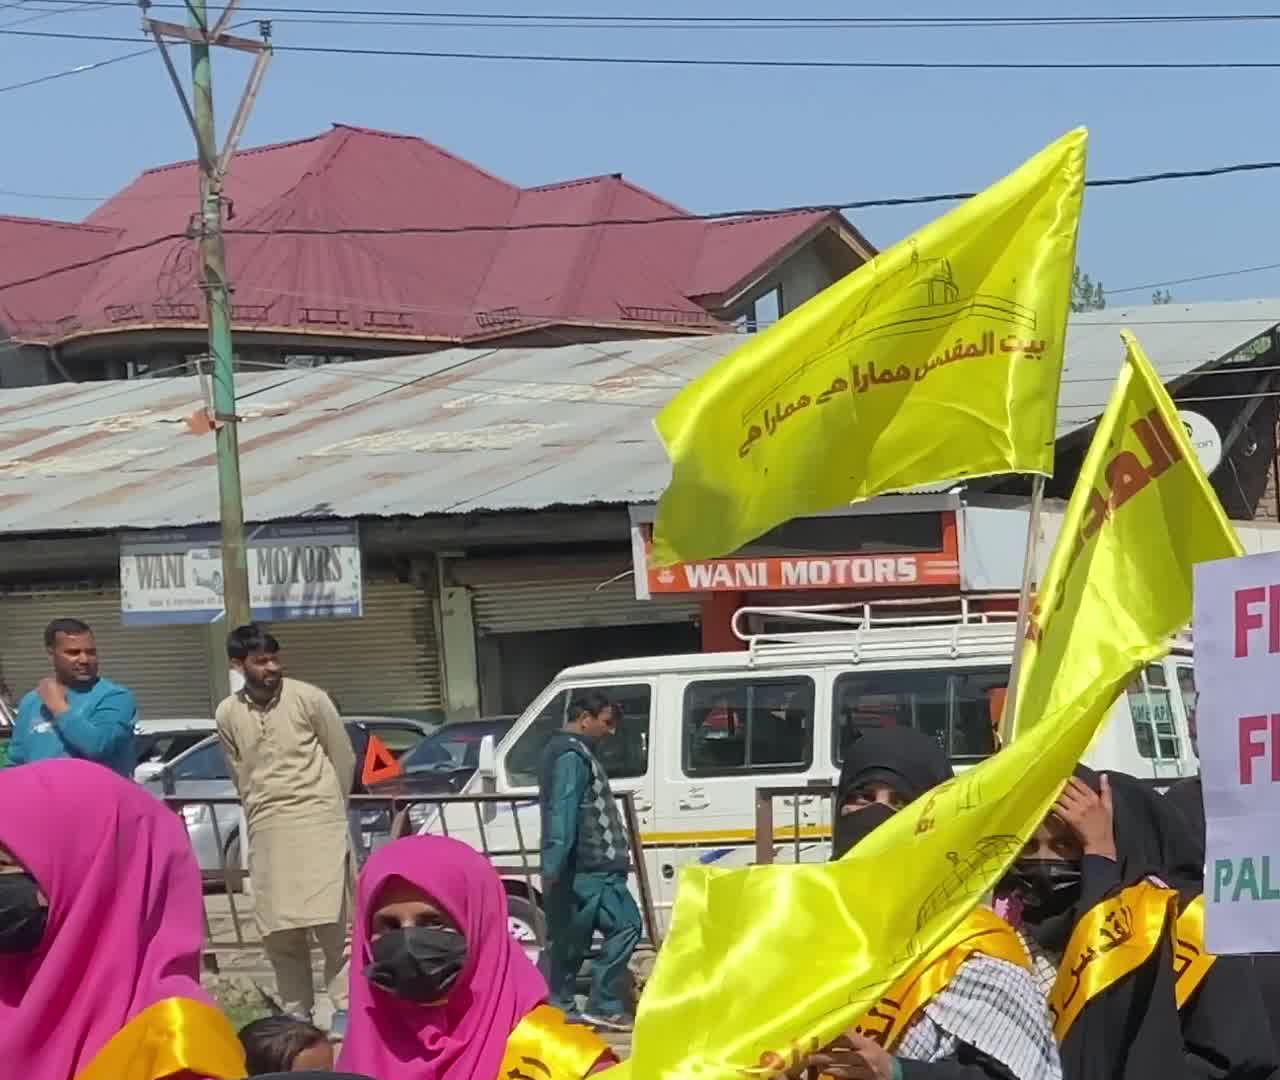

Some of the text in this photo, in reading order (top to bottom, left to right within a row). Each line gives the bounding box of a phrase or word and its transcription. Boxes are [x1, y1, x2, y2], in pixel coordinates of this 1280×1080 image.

[134, 546, 343, 589] WANI MOTORS
[683, 556, 917, 588] WANI MOTORS
